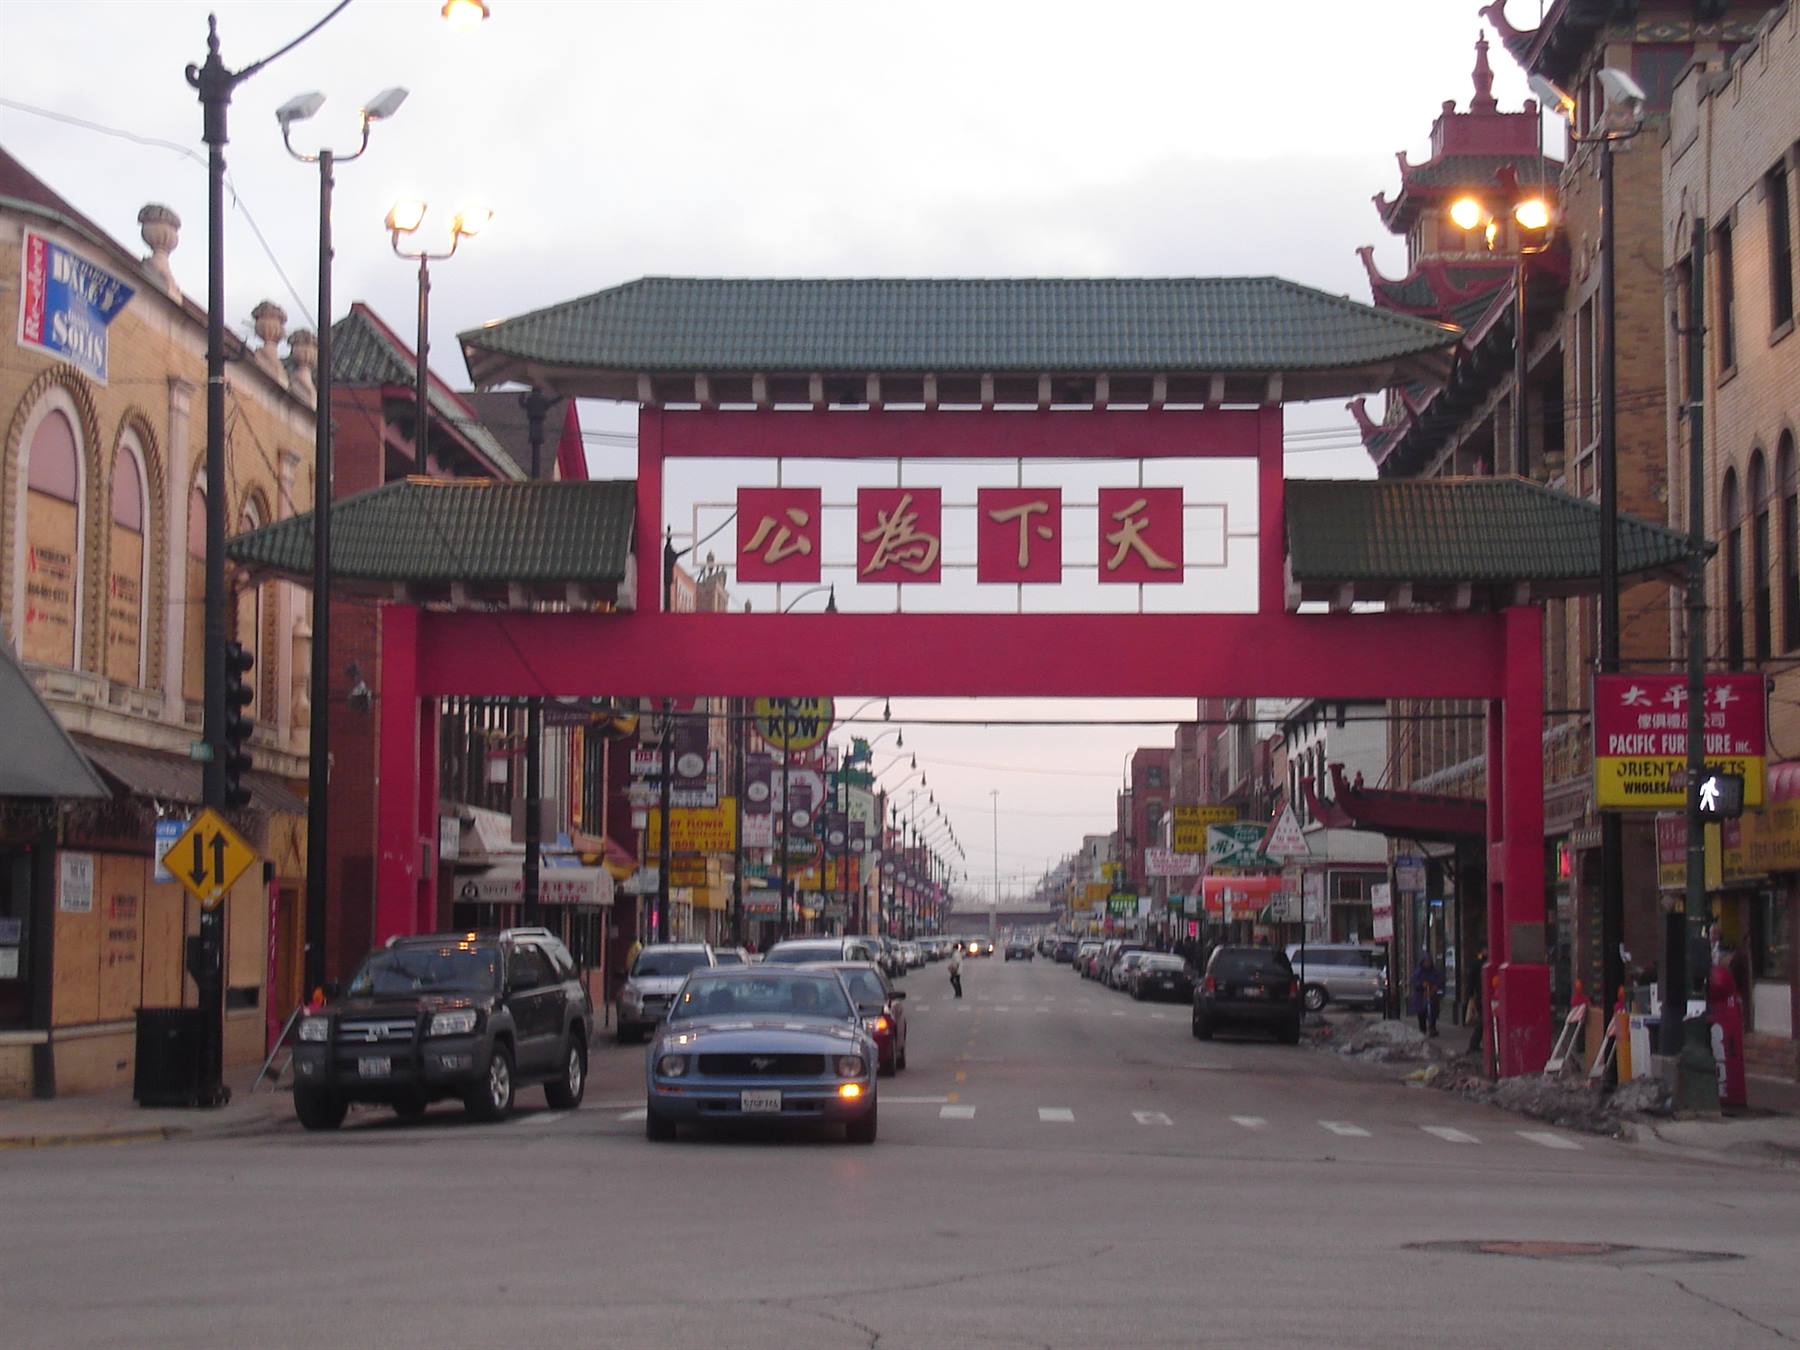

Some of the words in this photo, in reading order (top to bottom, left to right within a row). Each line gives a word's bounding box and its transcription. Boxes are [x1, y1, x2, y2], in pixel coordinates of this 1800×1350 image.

[768, 715, 819, 738] KOW
[1609, 733, 1656, 754] PACIFIC
[1661, 733, 1731, 754] FURURE
[1616, 760, 1687, 777] ORIENTA
